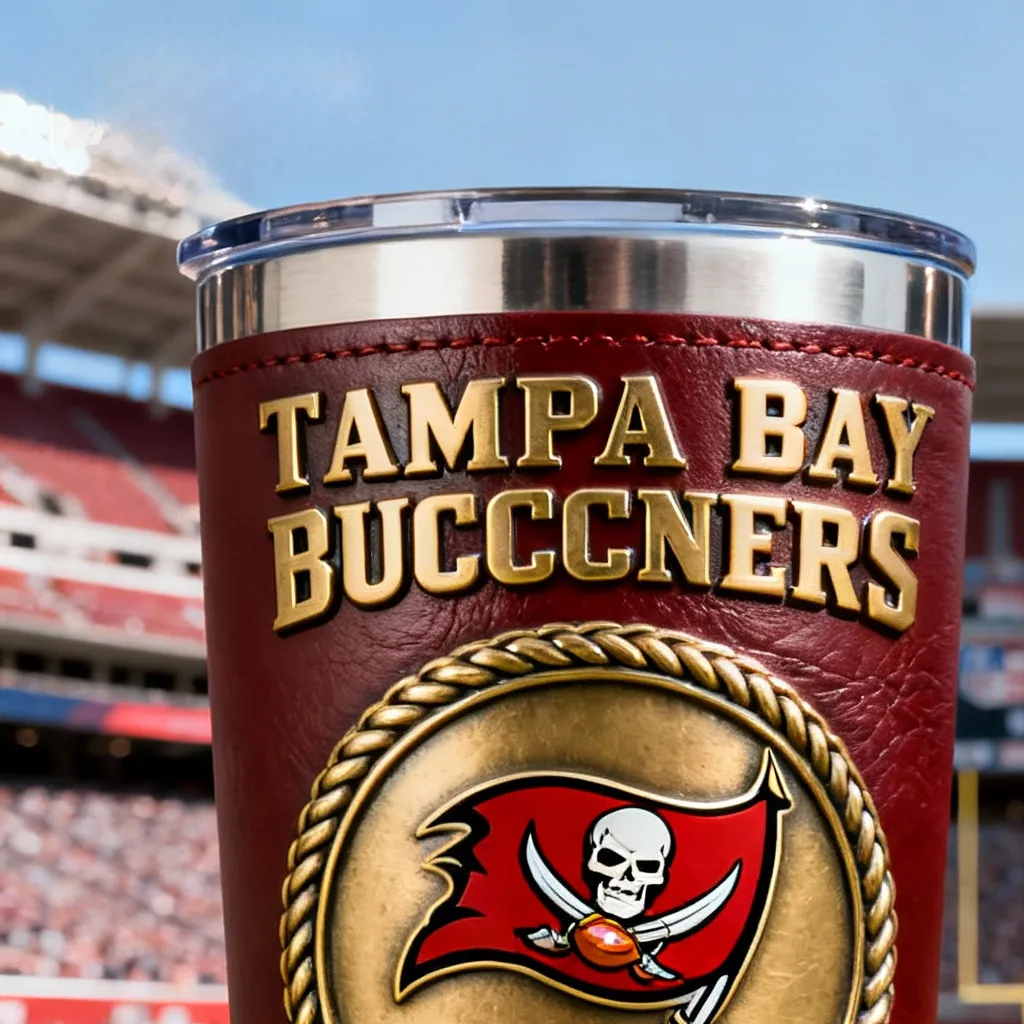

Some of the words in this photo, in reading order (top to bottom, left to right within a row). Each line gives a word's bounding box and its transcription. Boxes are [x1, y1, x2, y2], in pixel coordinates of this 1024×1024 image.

[258, 375, 688, 494] TAMPA
[732, 376, 936, 495] BAY
[267, 489, 922, 634] BUCCCNERS
